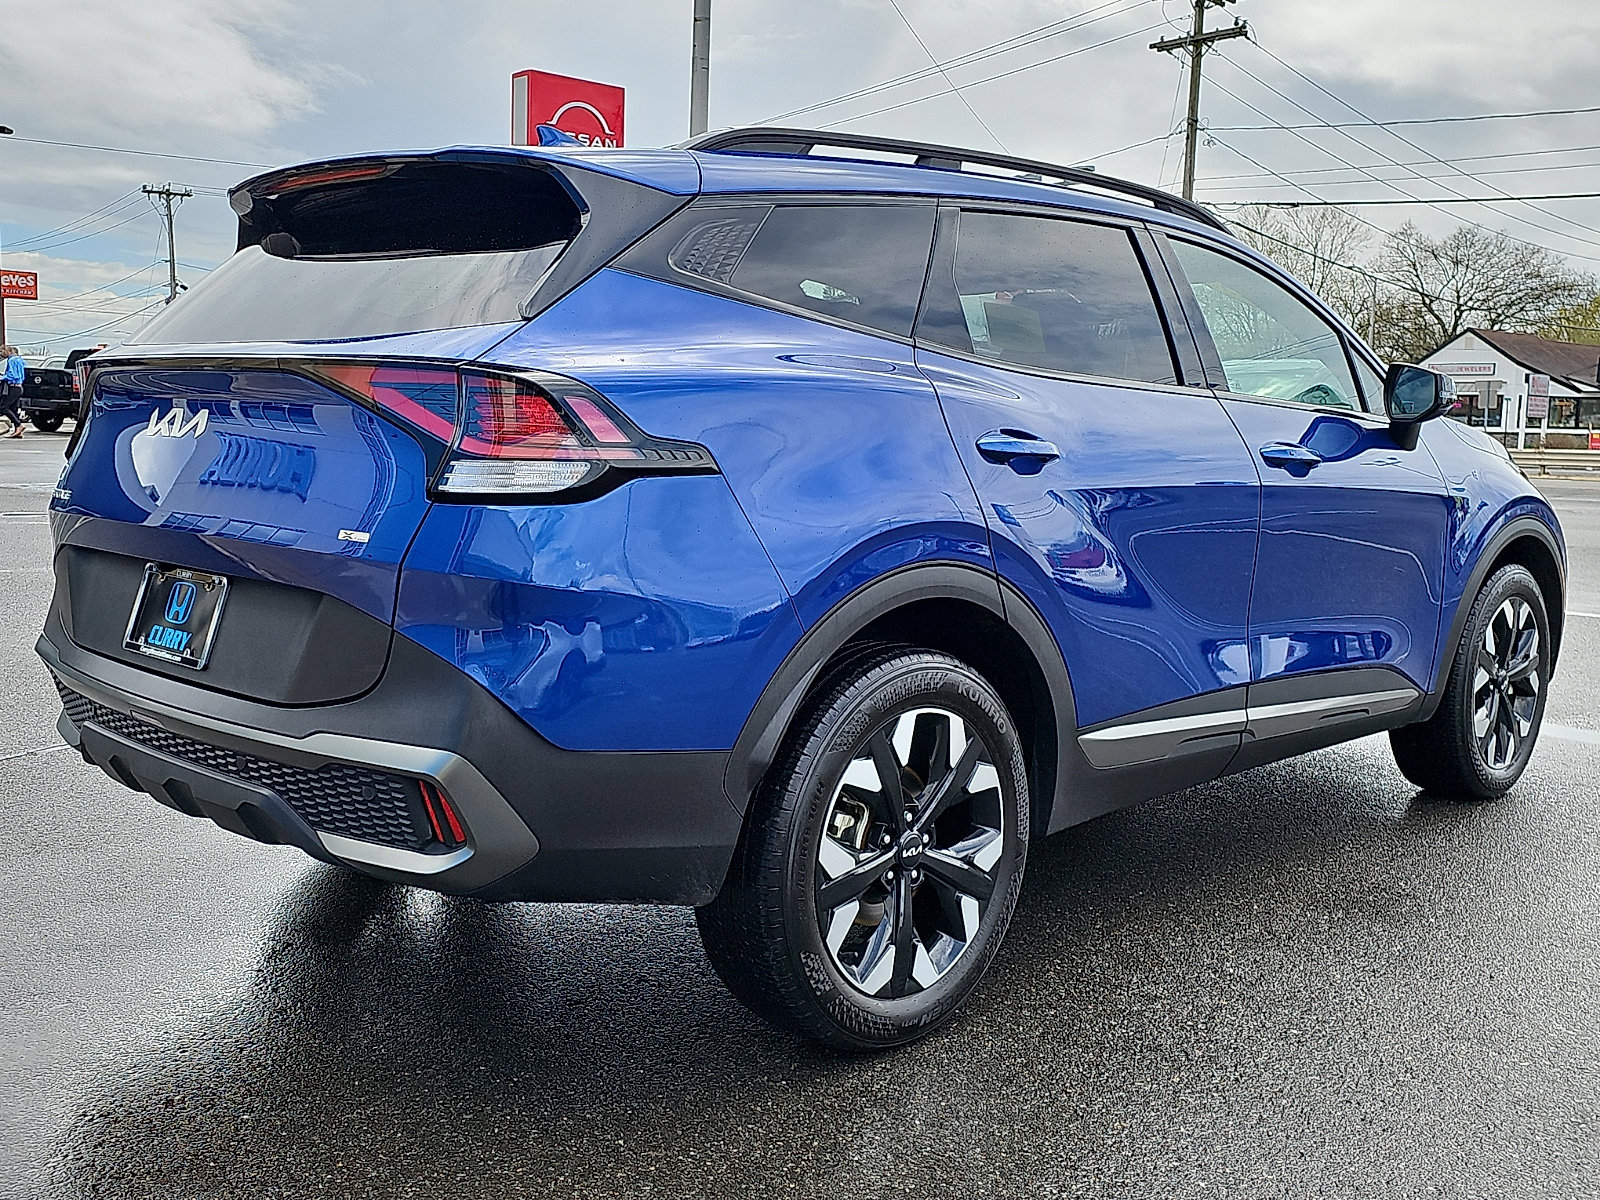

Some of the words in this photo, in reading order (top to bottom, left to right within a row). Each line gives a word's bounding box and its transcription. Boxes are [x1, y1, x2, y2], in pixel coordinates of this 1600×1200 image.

[146, 407, 210, 439] KIA
[147, 624, 193, 652] CURRY
[958, 682, 1007, 734] KUMHO
